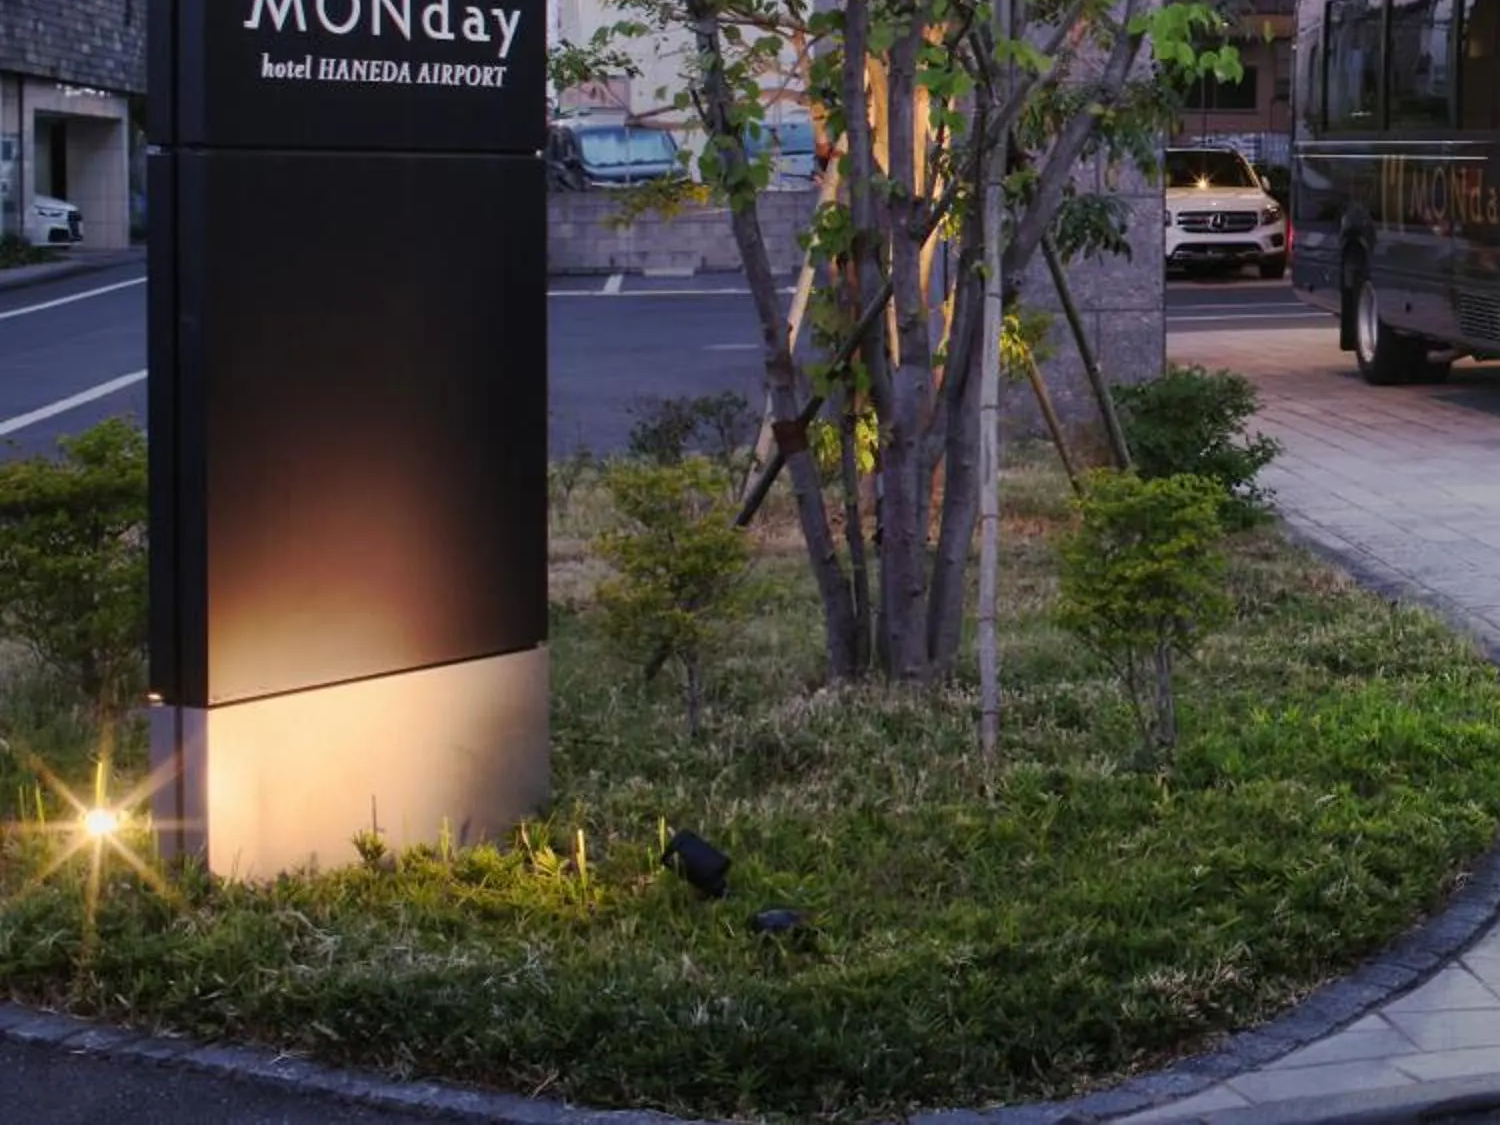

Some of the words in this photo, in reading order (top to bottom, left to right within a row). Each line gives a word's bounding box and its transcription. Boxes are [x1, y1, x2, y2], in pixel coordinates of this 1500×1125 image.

[261, 52, 312, 80] hotel
[317, 57, 412, 84] HANEDA
[416, 62, 507, 88] AIRPORT
